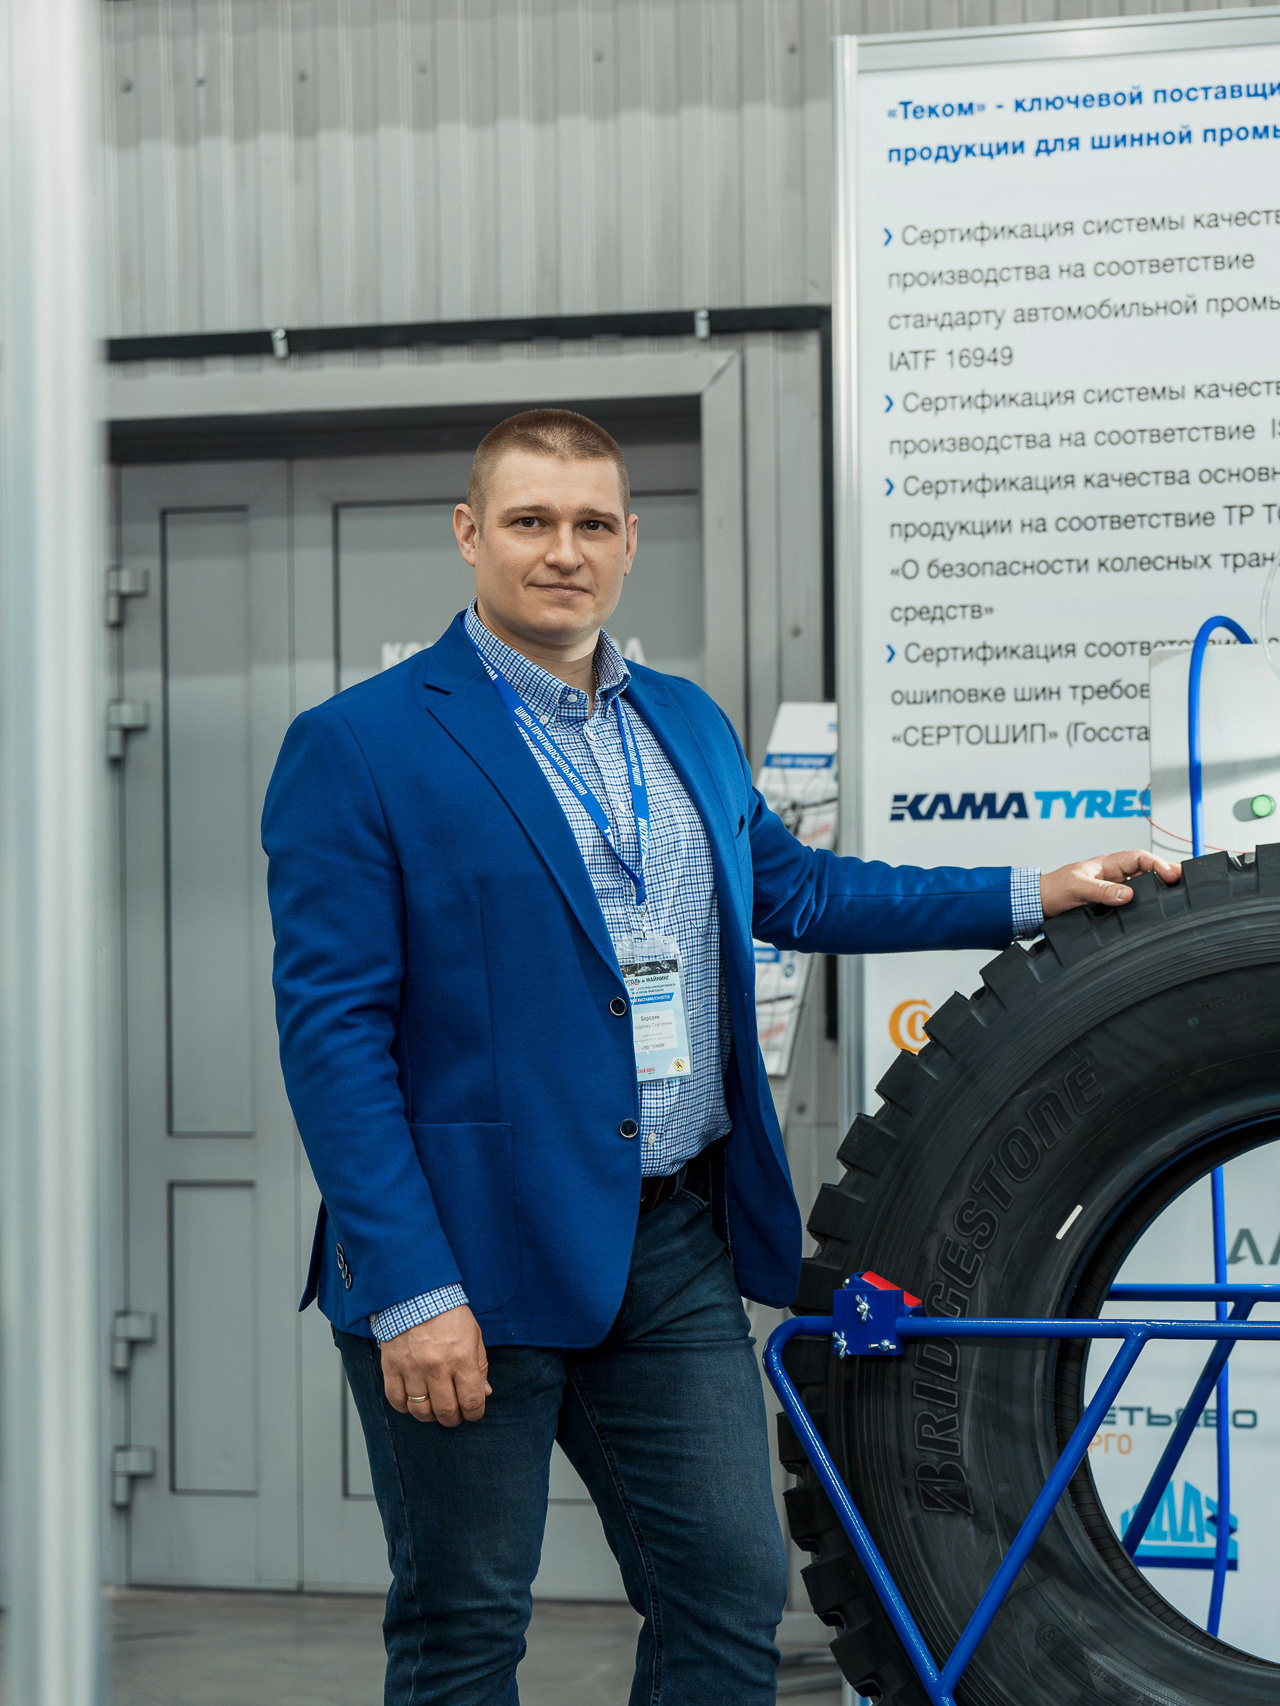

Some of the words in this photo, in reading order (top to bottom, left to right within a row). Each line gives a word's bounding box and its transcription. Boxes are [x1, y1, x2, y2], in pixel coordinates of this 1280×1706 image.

[887, 98, 988, 121] «Теком»
[1014, 87, 1143, 112] ключевой
[888, 137, 1025, 164] продукции
[1035, 133, 1080, 156] для
[1091, 124, 1192, 150] шинной
[901, 218, 1074, 251] Сертификация
[1083, 213, 1185, 235] системы
[888, 264, 1051, 290] производства
[1059, 262, 1086, 279] на
[1094, 250, 1256, 277] соответствие
[888, 308, 1005, 334] стандарту
[1013, 295, 1198, 325] автомобильной
[889, 351, 936, 373] IATF
[947, 347, 1014, 370] 16949
[902, 385, 1075, 418] Сертификация
[1084, 380, 1186, 404] системы
[889, 430, 1051, 457] производства
[1059, 429, 1087, 447] на
[1094, 421, 1256, 445] соответствие
[903, 470, 1075, 501] Сертификация
[1083, 467, 1190, 490] качества
[890, 514, 1012, 542] продукции
[1020, 515, 1047, 532] на
[1056, 508, 1215, 531] соответствие
[1224, 505, 1255, 526] ТР
[891, 560, 918, 580] «О
[927, 554, 1089, 579] безопасности
[1098, 550, 1212, 574] колесных
[890, 600, 994, 628] средств»
[904, 636, 1076, 667] Сертификация
[891, 684, 1006, 708] ошиповке
[1014, 684, 1061, 702] шин
[514, 706, 535, 729] ШИПЫ
[530, 723, 588, 796] ПРОТИВОСКОЛЬЖЕНИЯ
[891, 723, 1058, 747] «СЕРТОШИП»
[890, 791, 1029, 821] KAMA
[913, 1056, 1105, 1516] BRIDGESTONE
